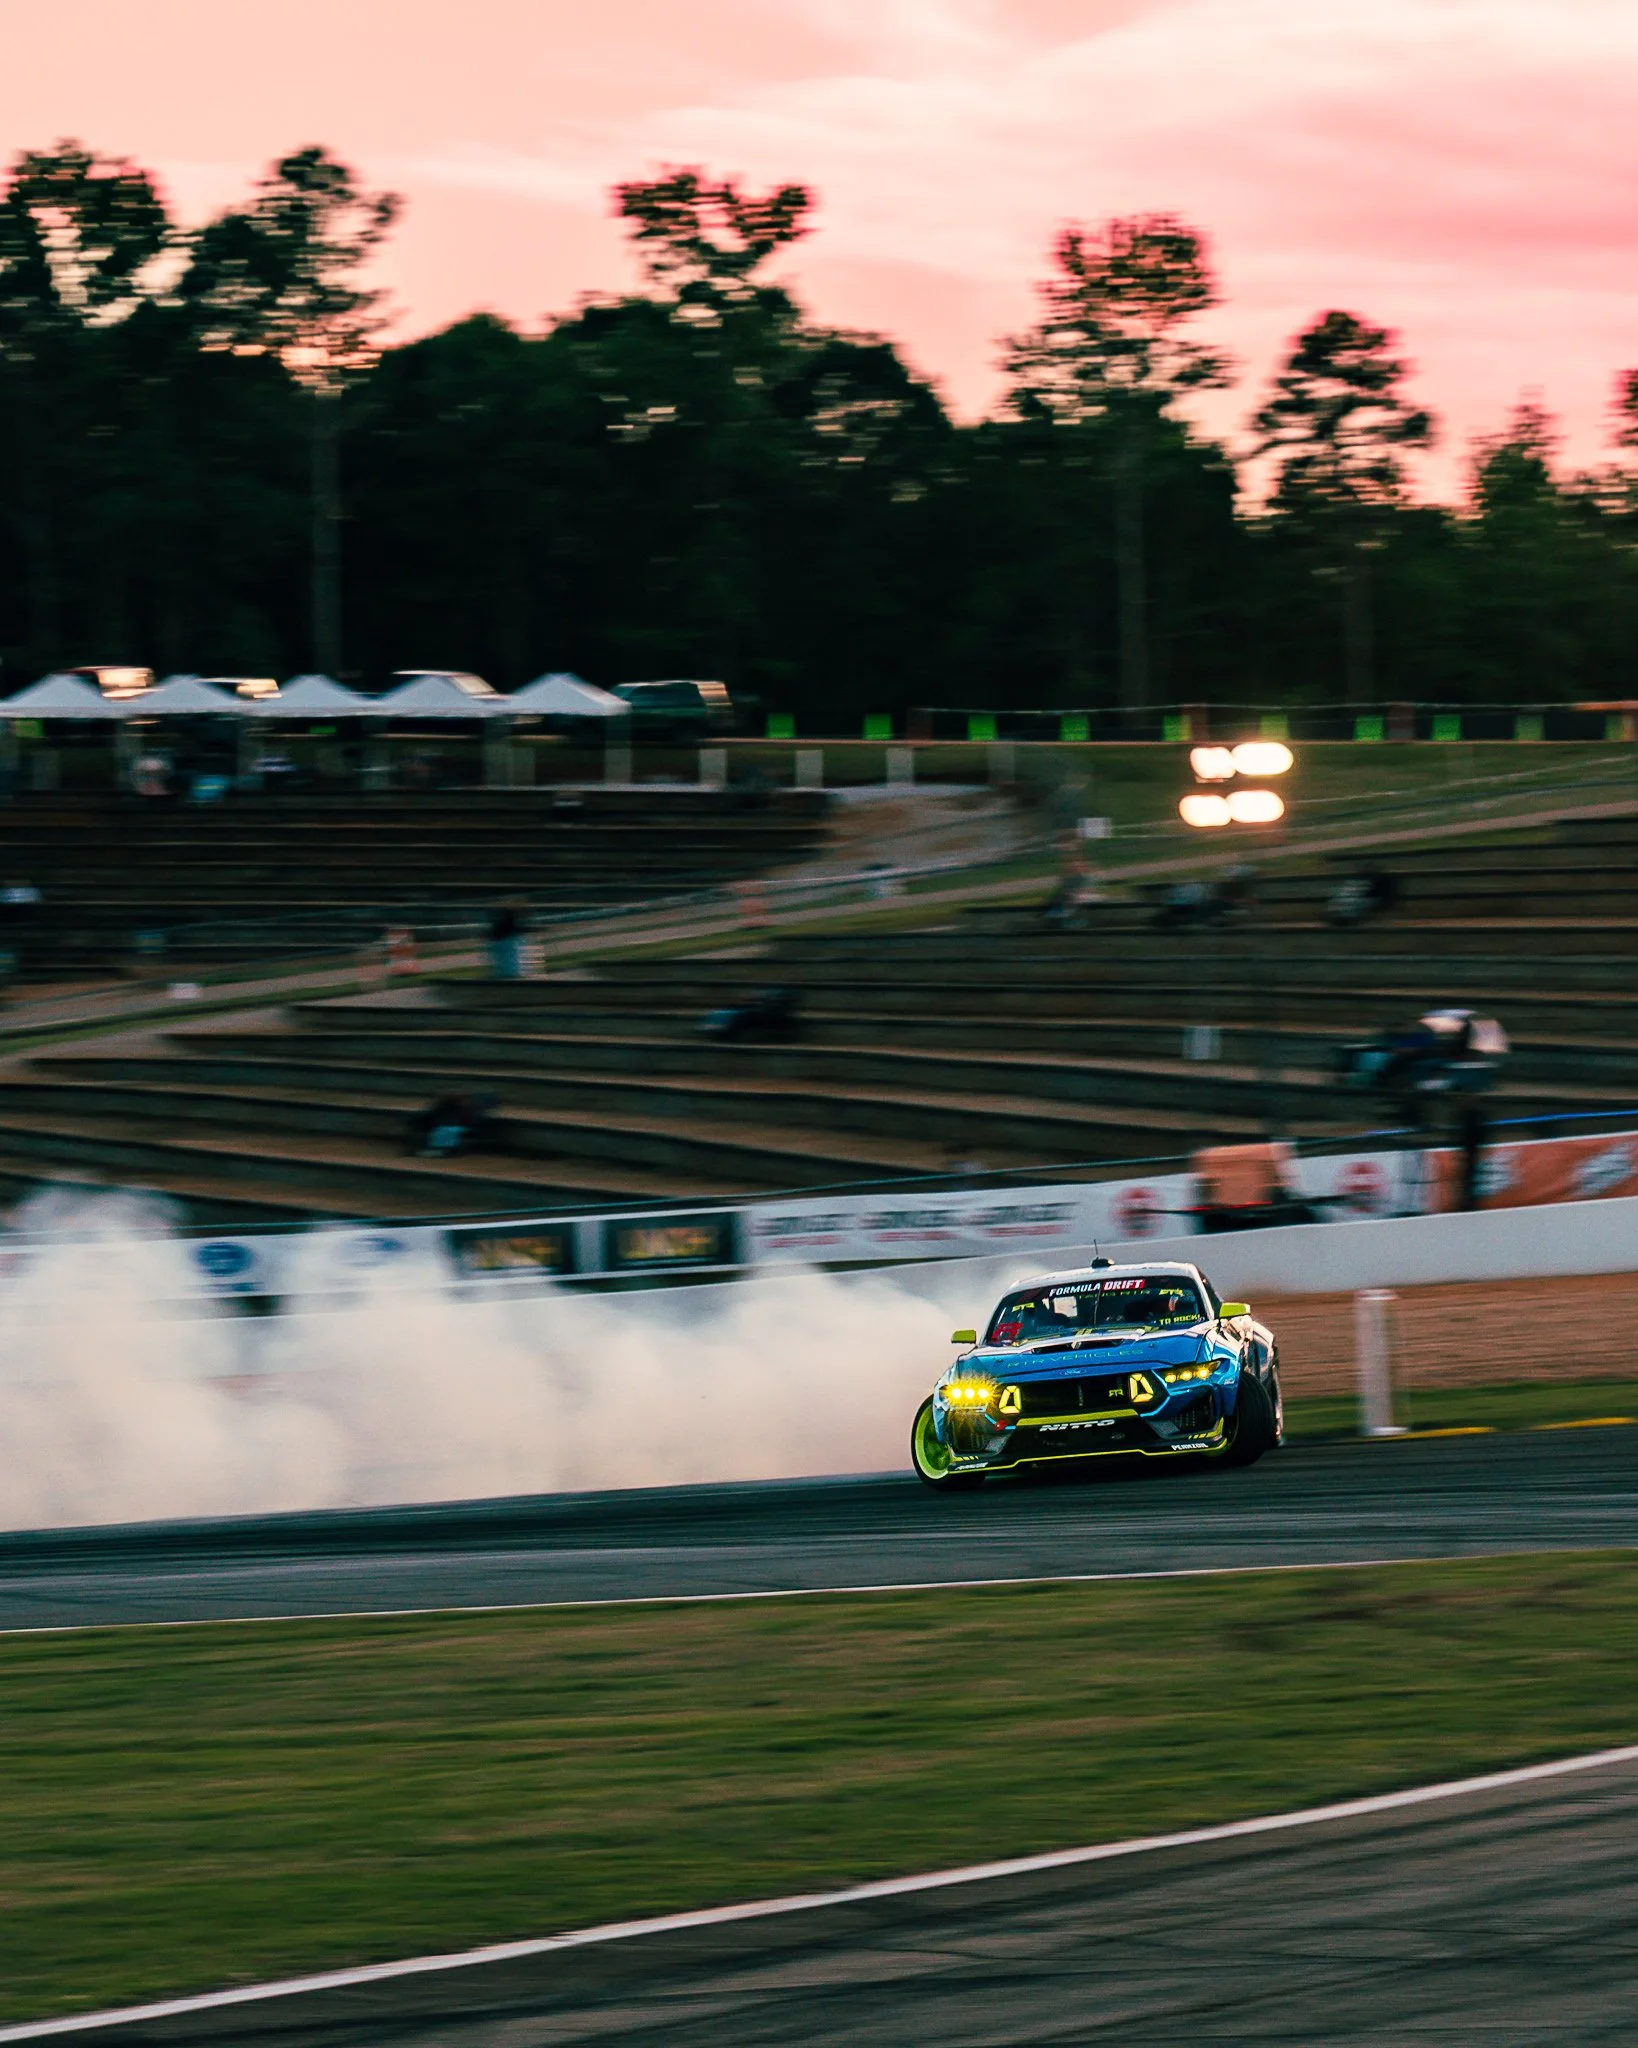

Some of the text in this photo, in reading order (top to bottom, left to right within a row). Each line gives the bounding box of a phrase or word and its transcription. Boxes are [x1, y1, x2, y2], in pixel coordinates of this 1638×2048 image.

[1049, 1279, 1144, 1297] FORMULA DRIFT
[1051, 1349, 1144, 1363] VEHICLES
[1039, 1419, 1116, 1432] NITTO
